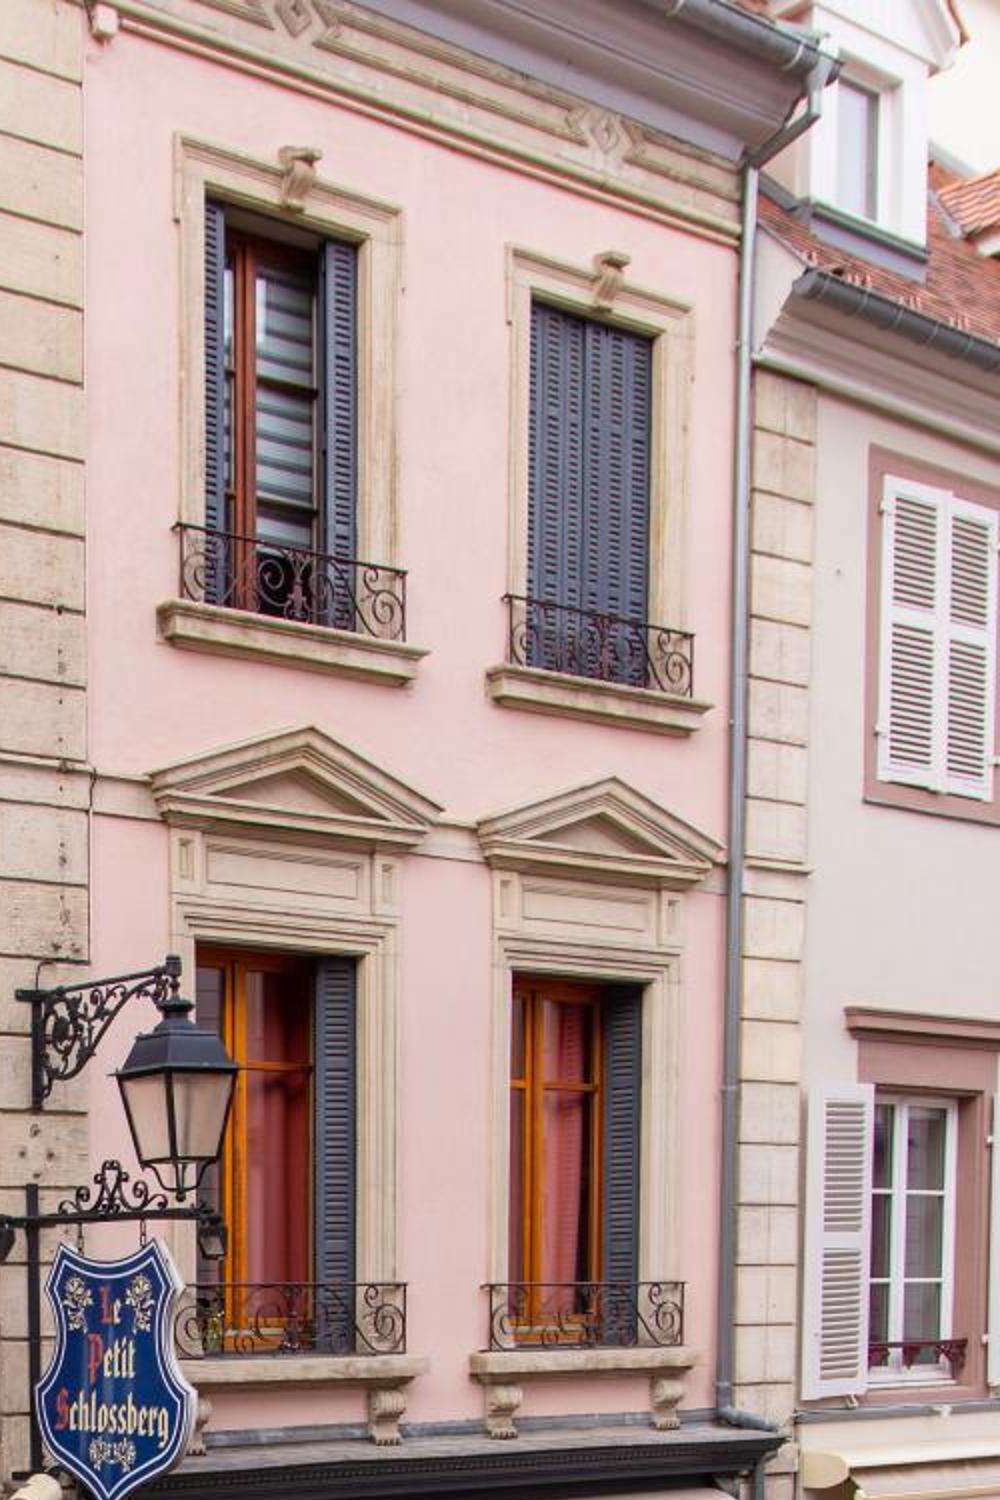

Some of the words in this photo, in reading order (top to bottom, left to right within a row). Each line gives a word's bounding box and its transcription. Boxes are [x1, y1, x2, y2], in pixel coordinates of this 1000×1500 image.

[99, 1285, 121, 1325] Le
[87, 1333, 135, 1384] Petit
[55, 1387, 169, 1447] Schlossberg
